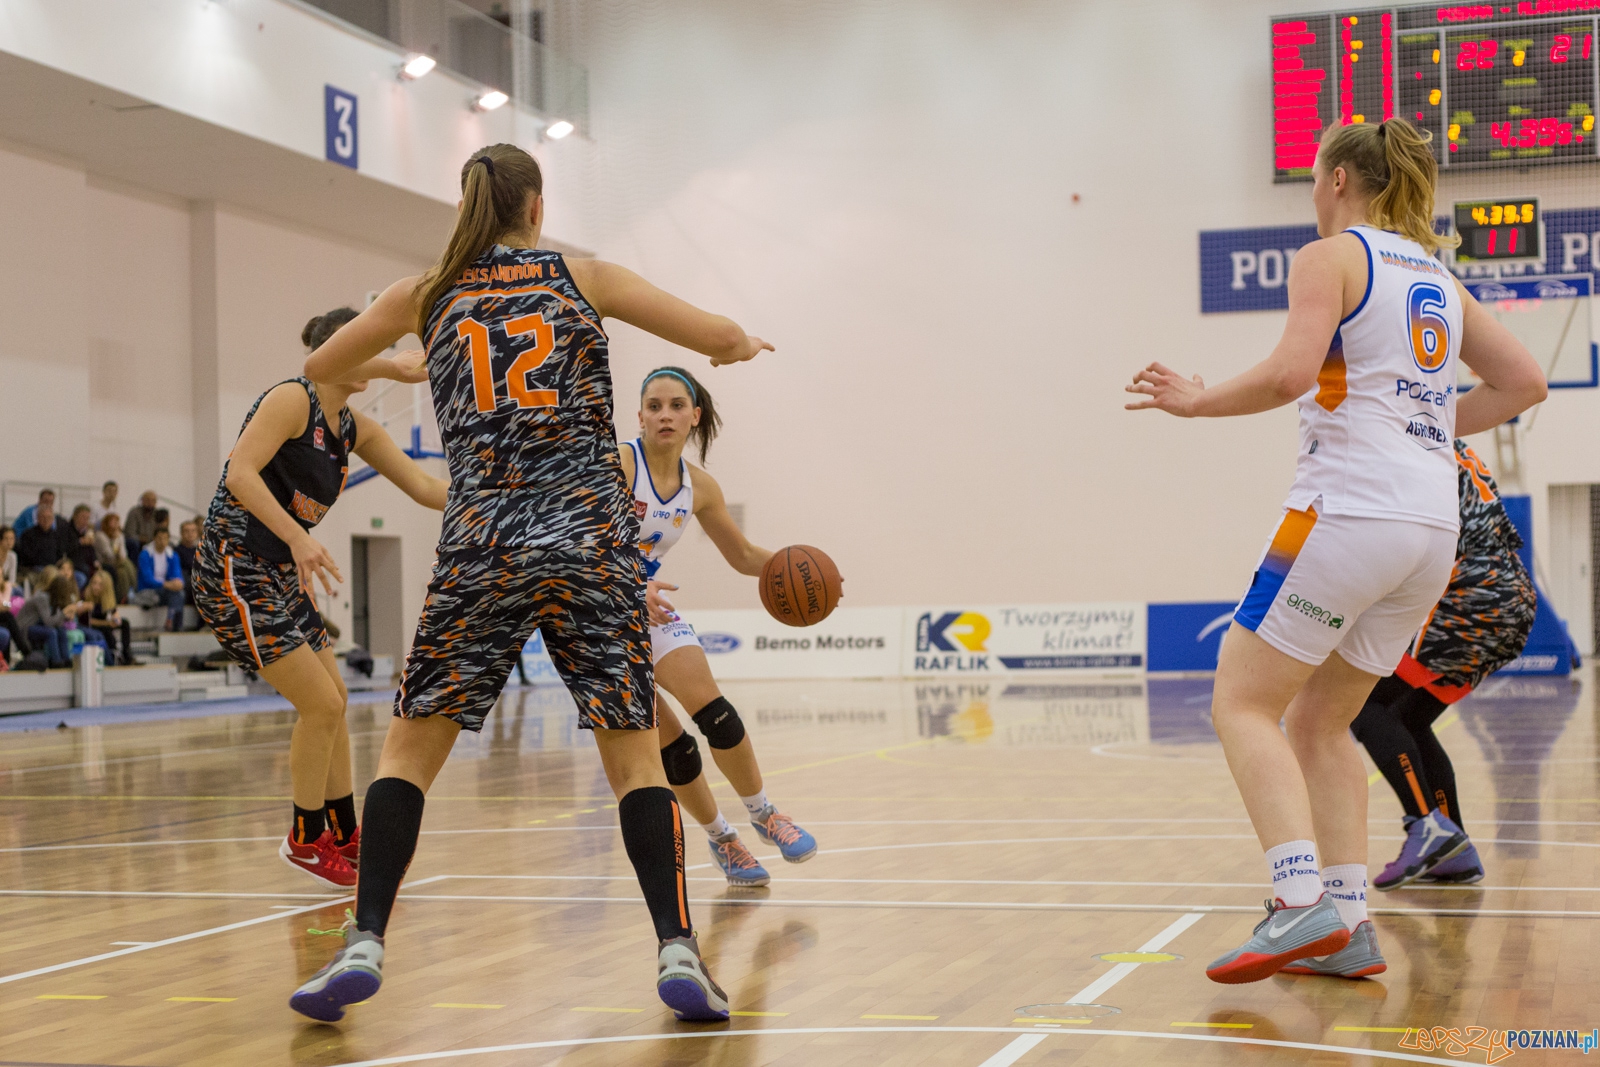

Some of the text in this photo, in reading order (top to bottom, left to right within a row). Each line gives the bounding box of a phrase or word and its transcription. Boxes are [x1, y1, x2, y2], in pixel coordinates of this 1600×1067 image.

[1456, 40, 1498, 71] 22
[1550, 34, 1593, 63] 21
[333, 94, 354, 159] 3
[1487, 227, 1519, 255] 11
[1407, 281, 1451, 374] 6
[456, 312, 560, 414] 12
[796, 561, 820, 615] SPALDING
[1000, 608, 1135, 631] Tworzymy
[1287, 593, 1332, 621] green
[1295, 606, 1327, 624] PARKING
[755, 635, 886, 651] Bemo Motors
[1043, 630, 1134, 650] klimat!
[915, 656, 989, 670] RAFLIK
